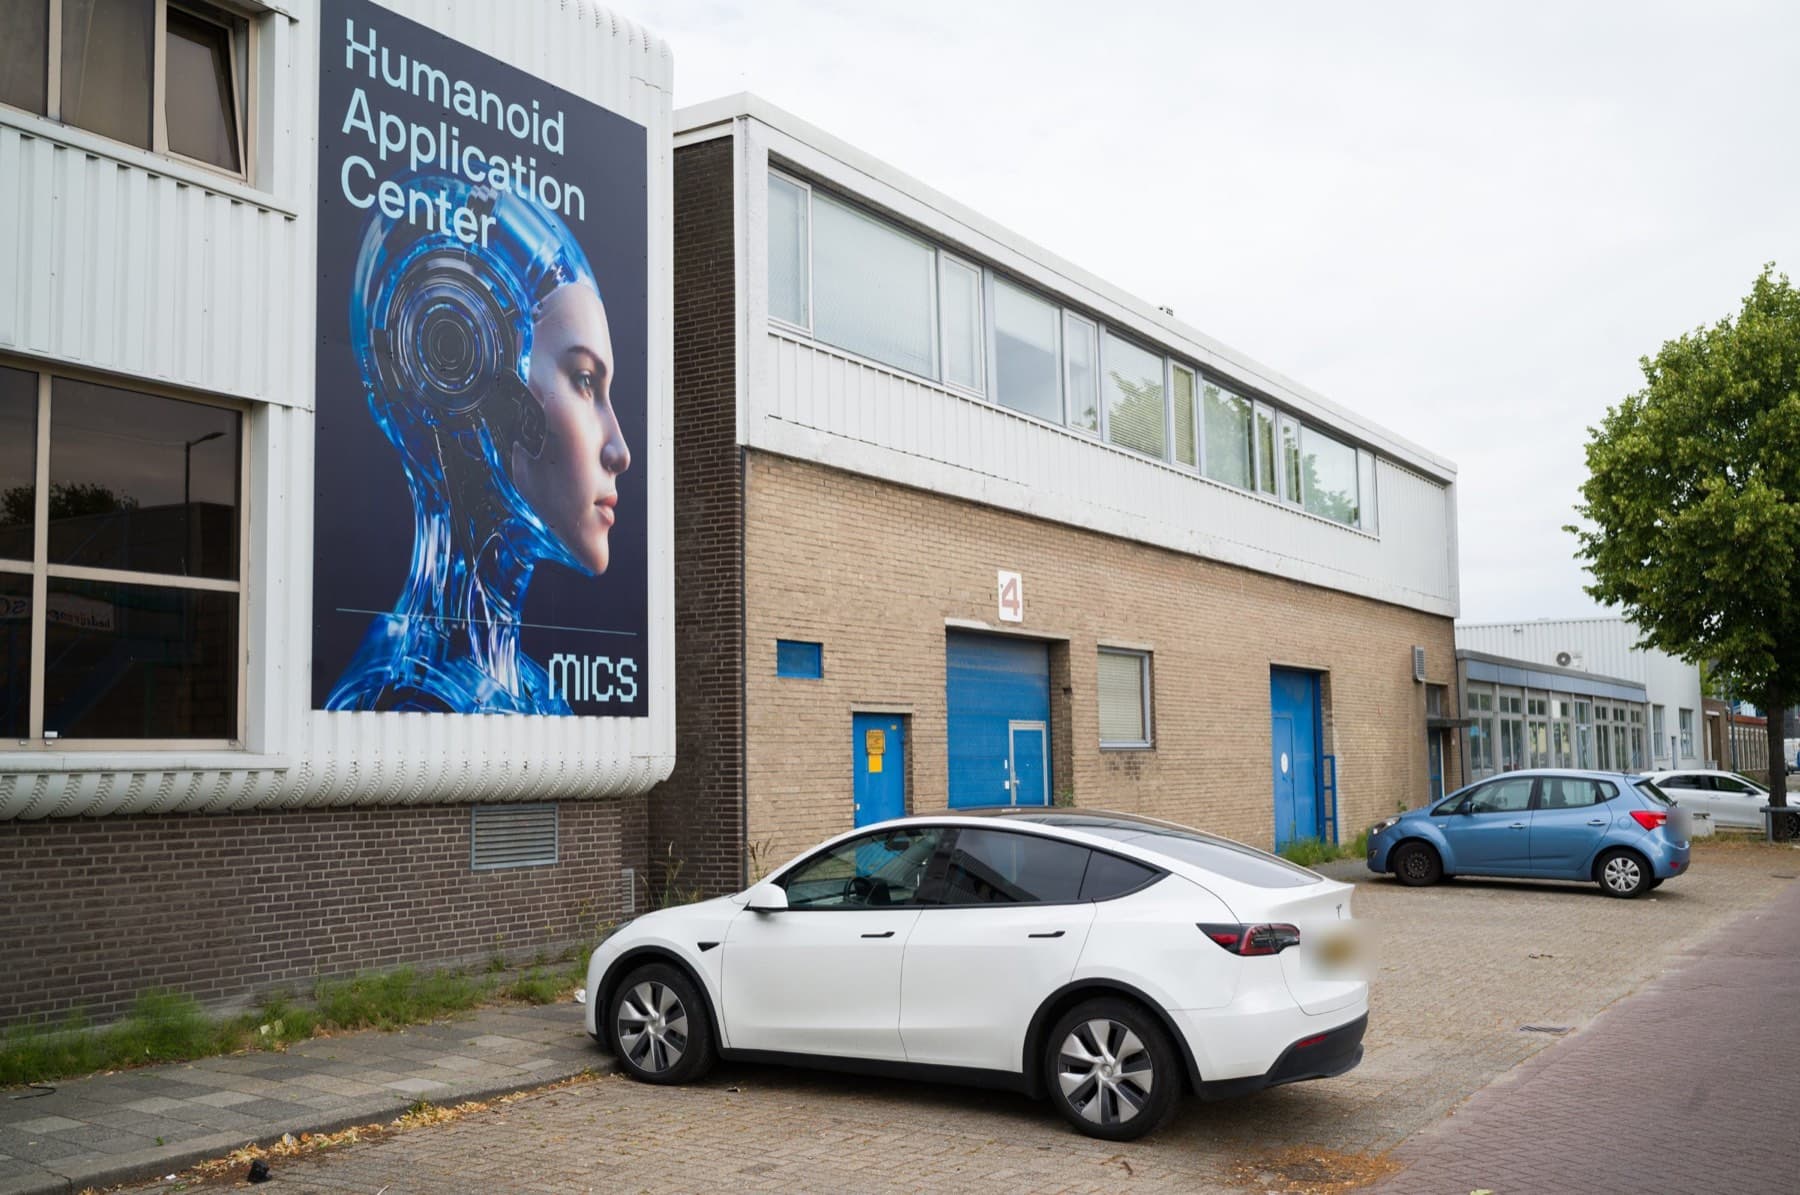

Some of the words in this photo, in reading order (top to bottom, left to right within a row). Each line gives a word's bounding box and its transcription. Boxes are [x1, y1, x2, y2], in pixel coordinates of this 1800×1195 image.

[345, 18, 565, 156] Humanoid
[340, 155, 497, 249] Center
[341, 87, 586, 221] Application
[1002, 577, 1020, 617] 4
